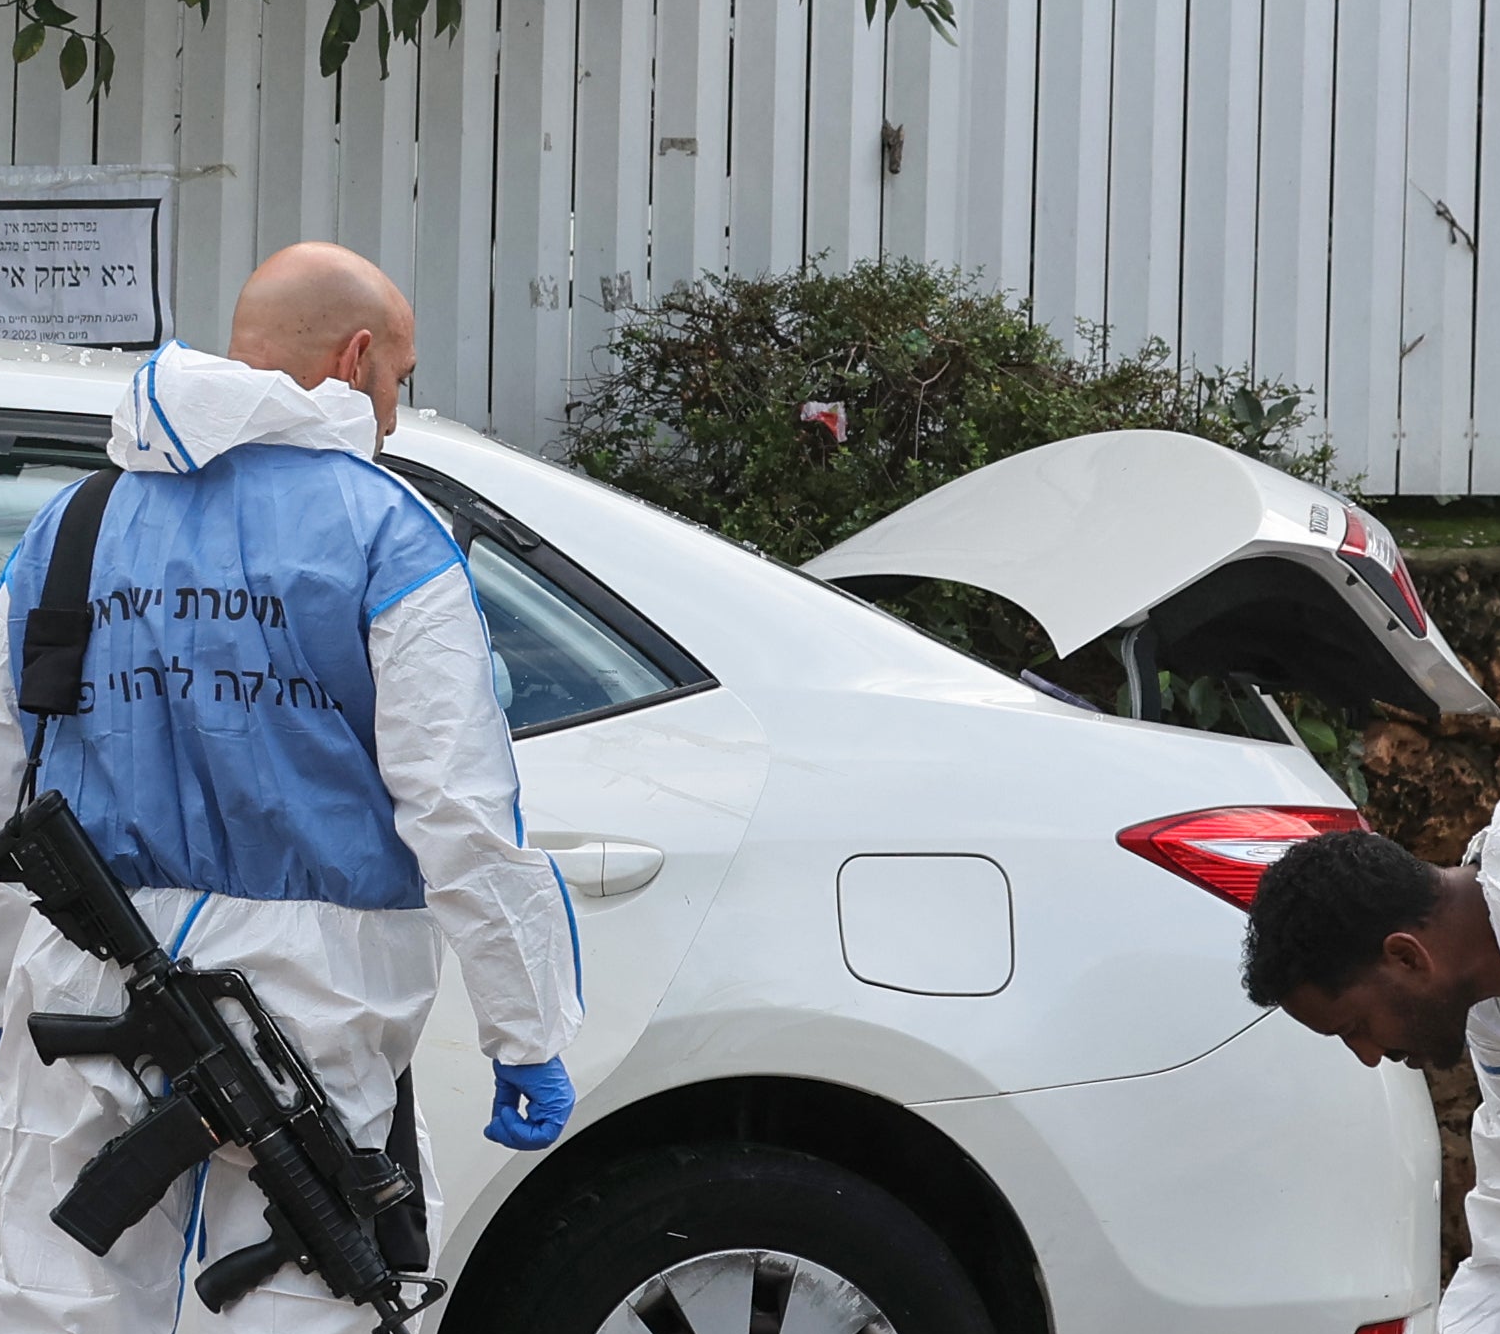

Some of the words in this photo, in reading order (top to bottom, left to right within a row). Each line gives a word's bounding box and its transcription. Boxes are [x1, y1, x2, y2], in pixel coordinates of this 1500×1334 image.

[4, 223, 19, 236] אין
[22, 222, 58, 233] באהבת
[62, 222, 97, 233] נפרדים
[63, 240, 100, 251] משפחה
[35, 258, 90, 294] יצחק
[102, 264, 137, 287] גיא
[9, 314, 27, 324] חיים
[31, 314, 64, 324] ברעננה
[105, 313, 138, 323] השבעה
[40, 330, 65, 342] ראשון
[69, 330, 88, 340] מיום
